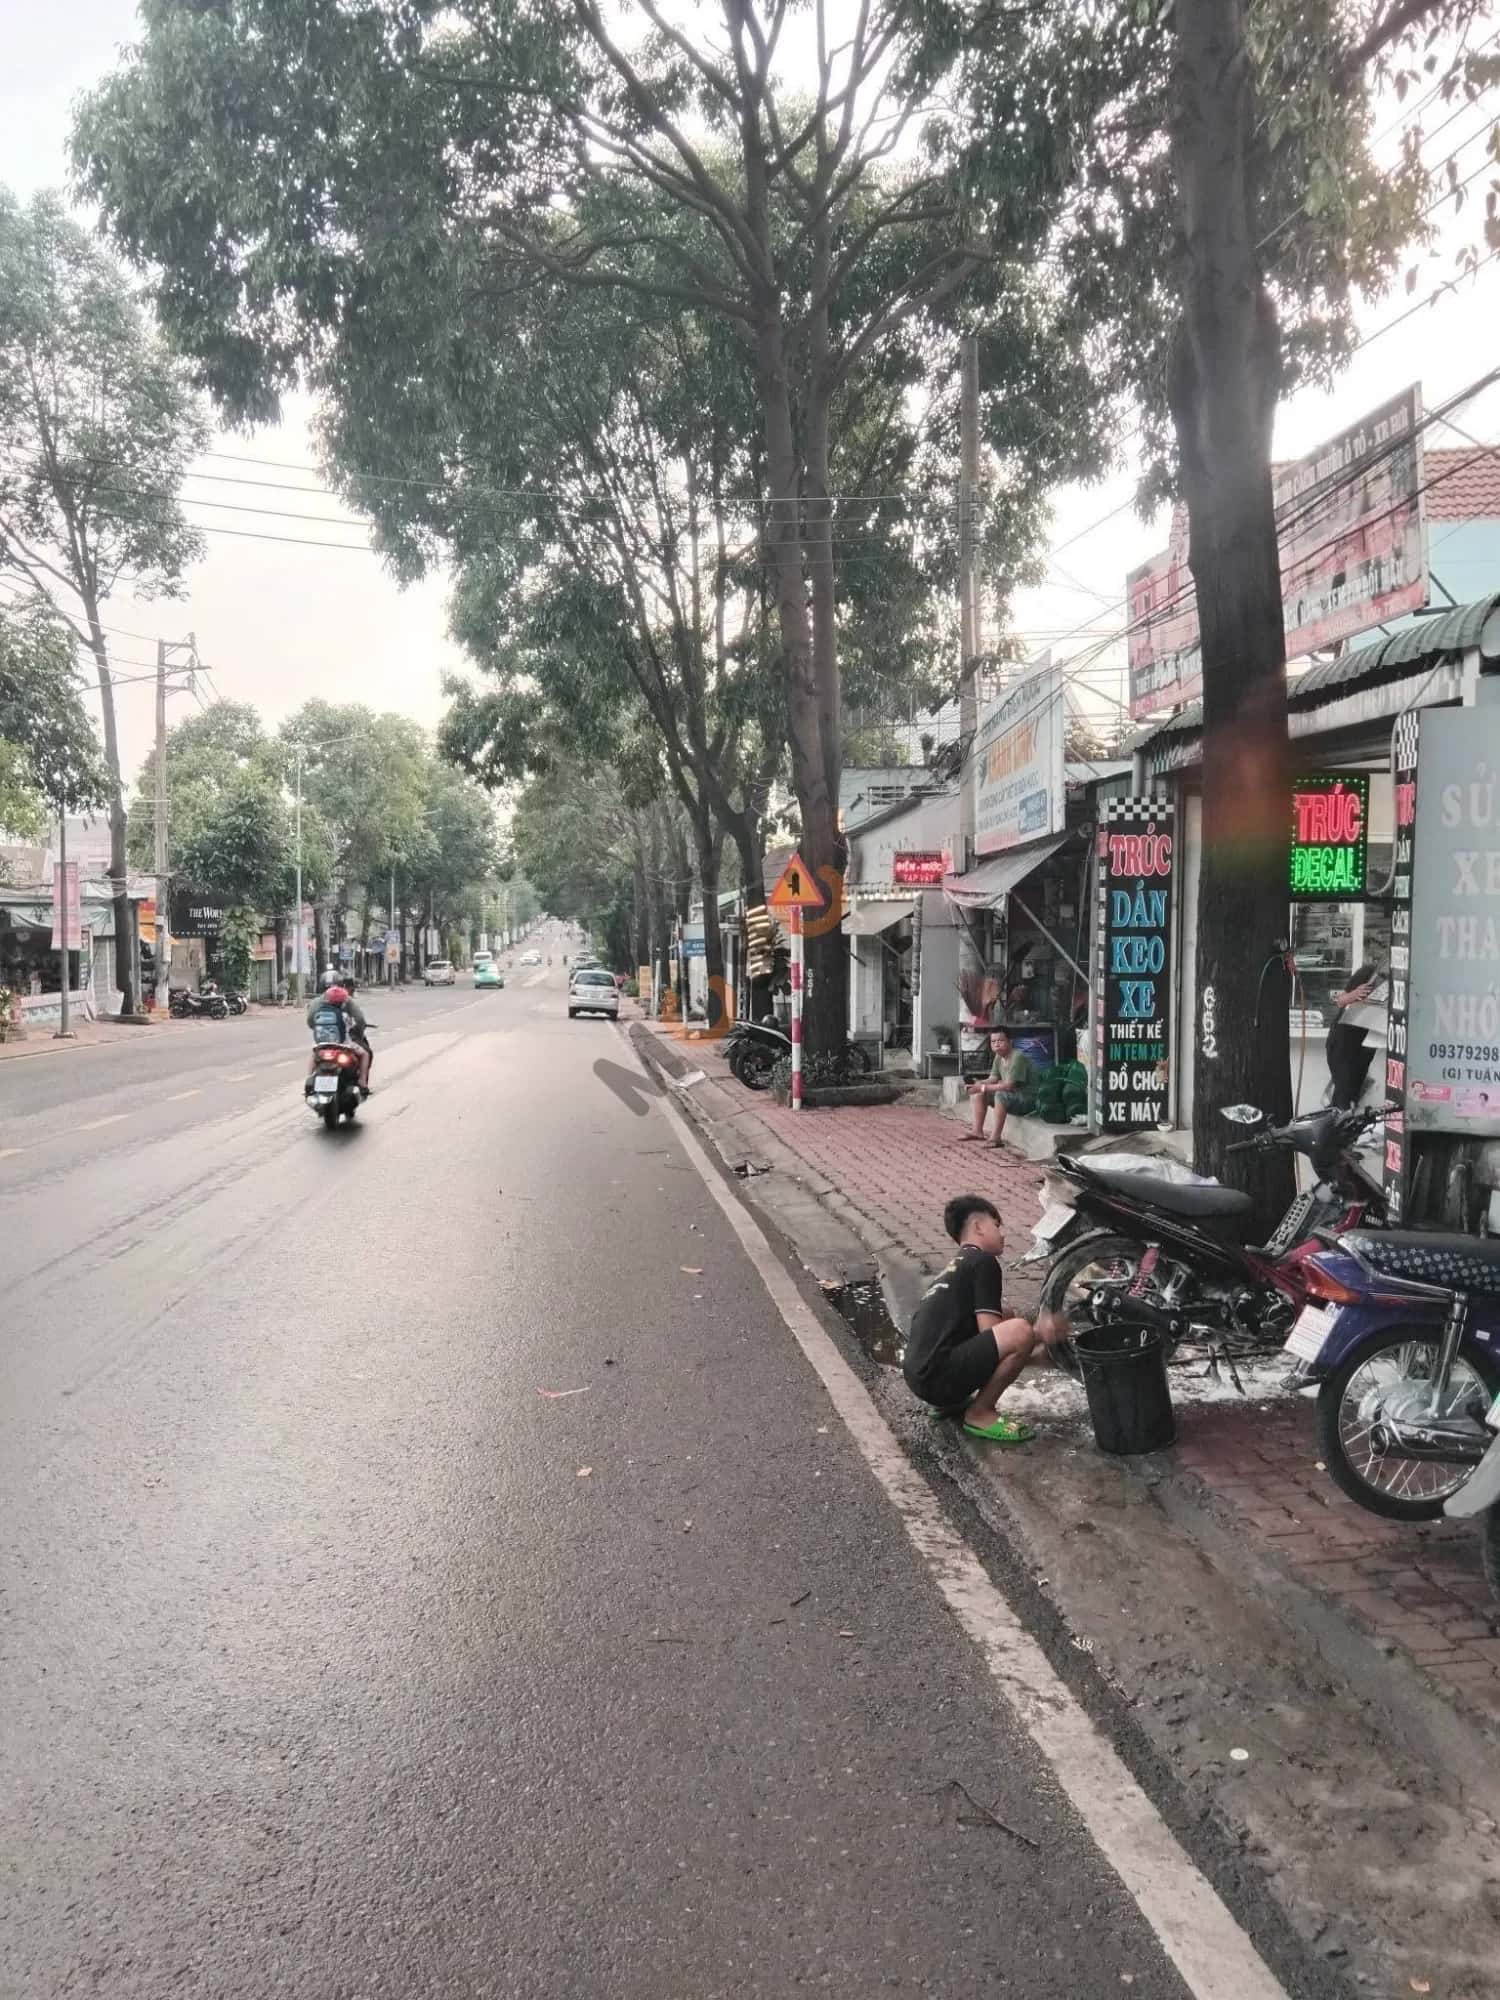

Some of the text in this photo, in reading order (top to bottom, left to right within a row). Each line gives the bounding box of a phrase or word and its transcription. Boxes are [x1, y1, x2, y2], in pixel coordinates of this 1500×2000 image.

[1296, 783, 1362, 843] TRÚC
[1441, 761, 1500, 828] SỬ
[1109, 822, 1172, 877] TRÚC
[1294, 846, 1359, 888] DECAL
[1111, 879, 1168, 928] DÁN
[1111, 936, 1166, 974] KEO
[1118, 981, 1156, 1018] XE
[1392, 980, 1406, 1011] XE
[1109, 1018, 1164, 1039] THIẾT KẾ
[1109, 1043, 1165, 1062] IN TEM XE
[1108, 1062, 1128, 1091] ĐỒ
[1108, 1096, 1162, 1122] XE MÁY
